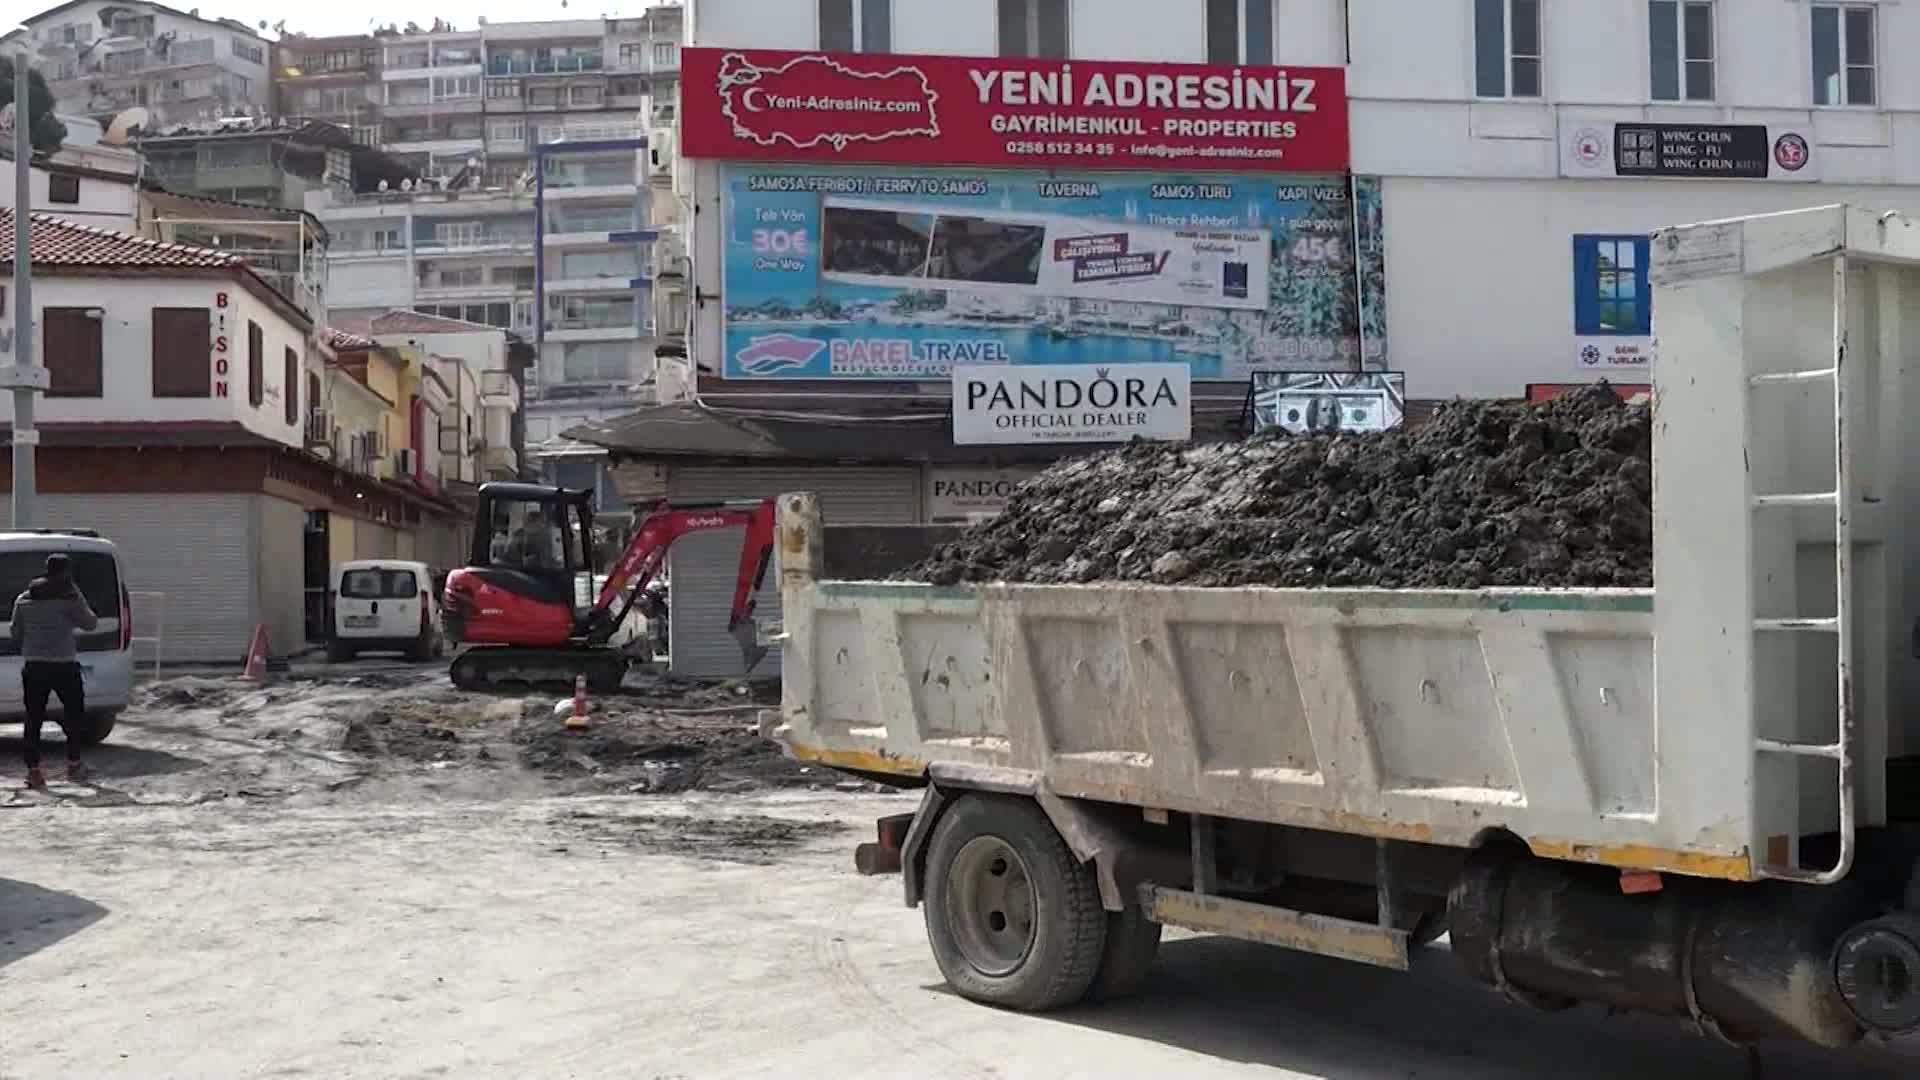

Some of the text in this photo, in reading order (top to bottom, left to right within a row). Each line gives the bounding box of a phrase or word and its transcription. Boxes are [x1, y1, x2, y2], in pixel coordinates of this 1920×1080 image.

[970, 64, 1317, 112] YENİ ADRESİNİZ
[991, 113, 1147, 135] GAYRİMENKUL
[1164, 119, 1297, 139] PROPERTIES
[1661, 131, 1732, 143] WING CHUN
[1663, 145, 1697, 156] KUNG
[1706, 146, 1722, 156] FU
[1663, 159, 1697, 169] WING
[1700, 159, 1734, 169] CHUN
[750, 177, 806, 191] SAMOSA
[875, 180, 917, 193] FERRY
[920, 181, 939, 193] TO
[942, 181, 987, 195] SAMOS
[1038, 183, 1099, 197] TAVERNA
[1151, 184, 1232, 199] SAMOS TURU
[1278, 187, 1308, 201] KAPI
[831, 340, 1008, 363] BAREL TRAVEL
[967, 376, 1178, 411] PANDORA
[996, 413, 1147, 429] OFFICIAL DEALER
